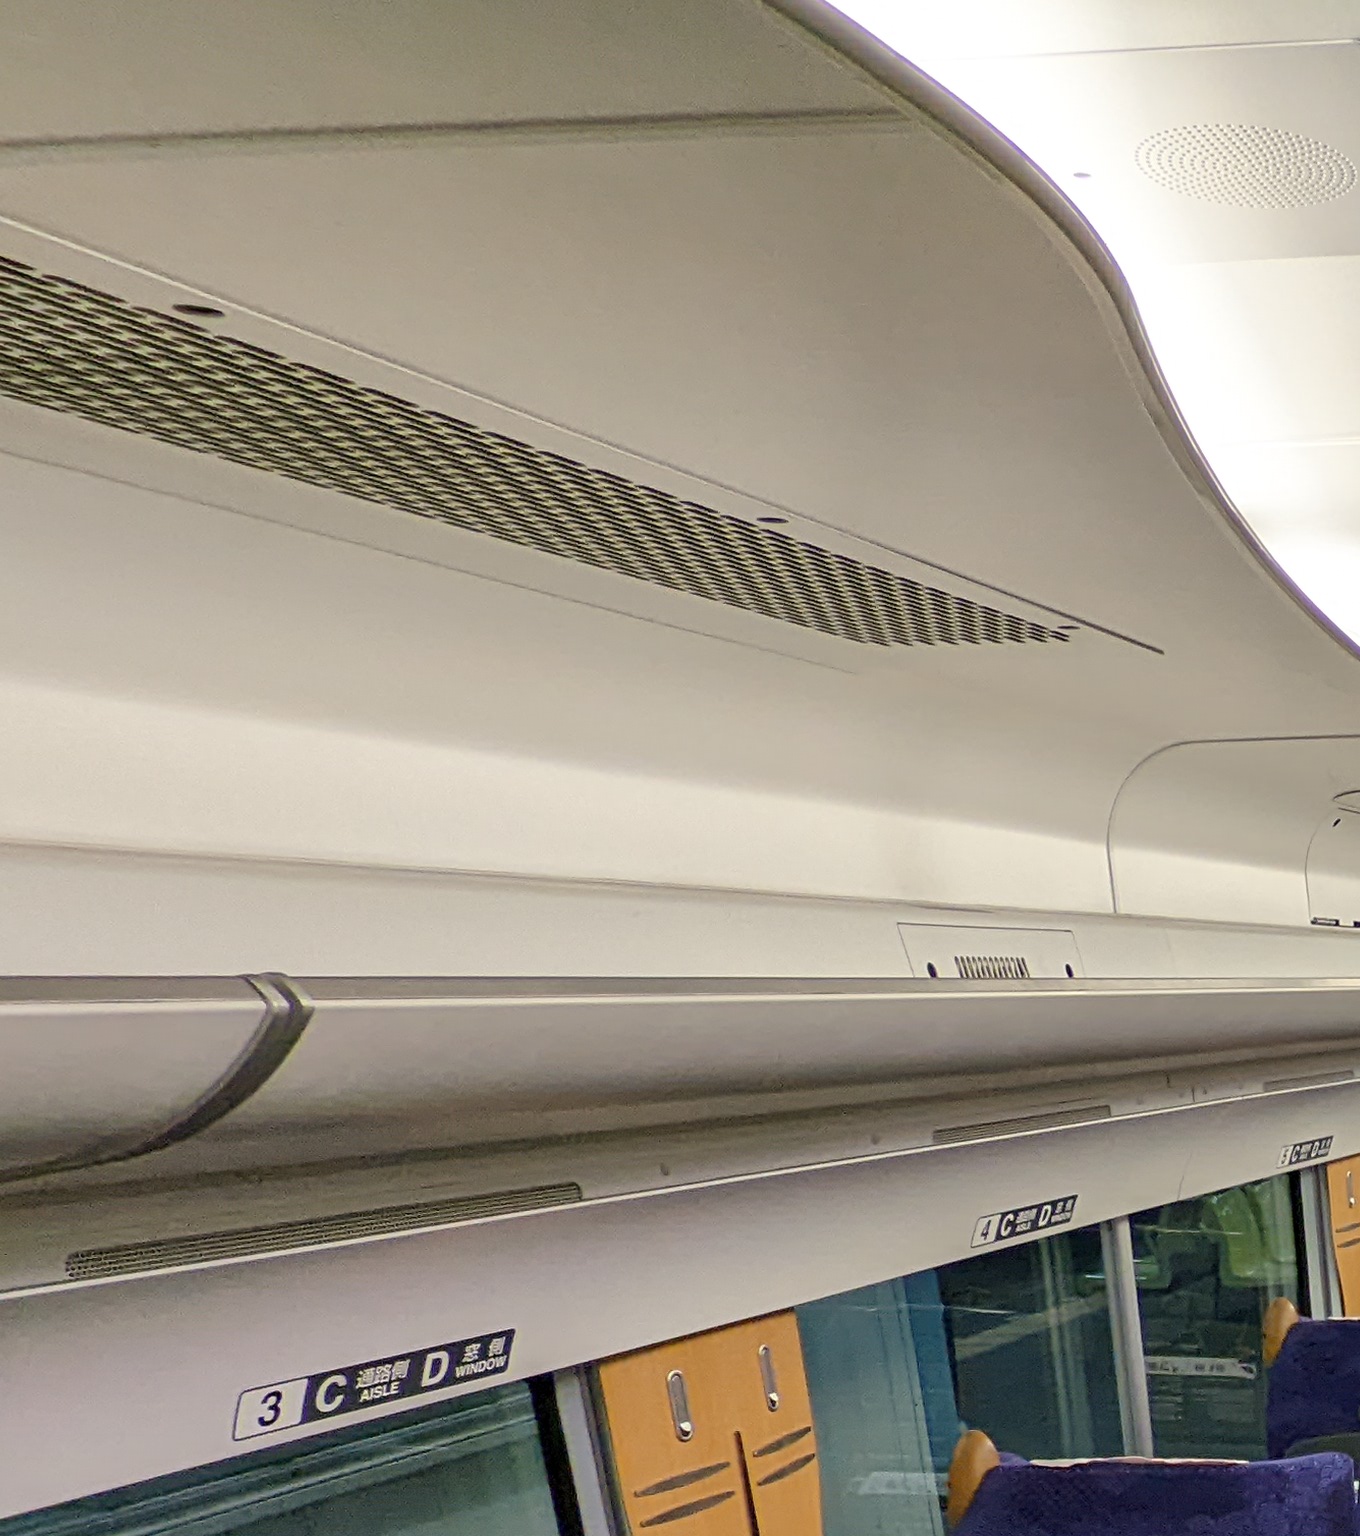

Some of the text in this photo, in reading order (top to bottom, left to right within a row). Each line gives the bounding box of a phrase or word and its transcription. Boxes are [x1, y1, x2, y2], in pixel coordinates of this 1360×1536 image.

[980, 1219, 991, 1241] 4
[1000, 1212, 1015, 1237] C
[1038, 1205, 1051, 1227] D
[454, 1355, 507, 1378] WINDOW
[257, 1336, 505, 1427] 3 C 通路側 D 窓側
[359, 1381, 399, 1402] AISLE
